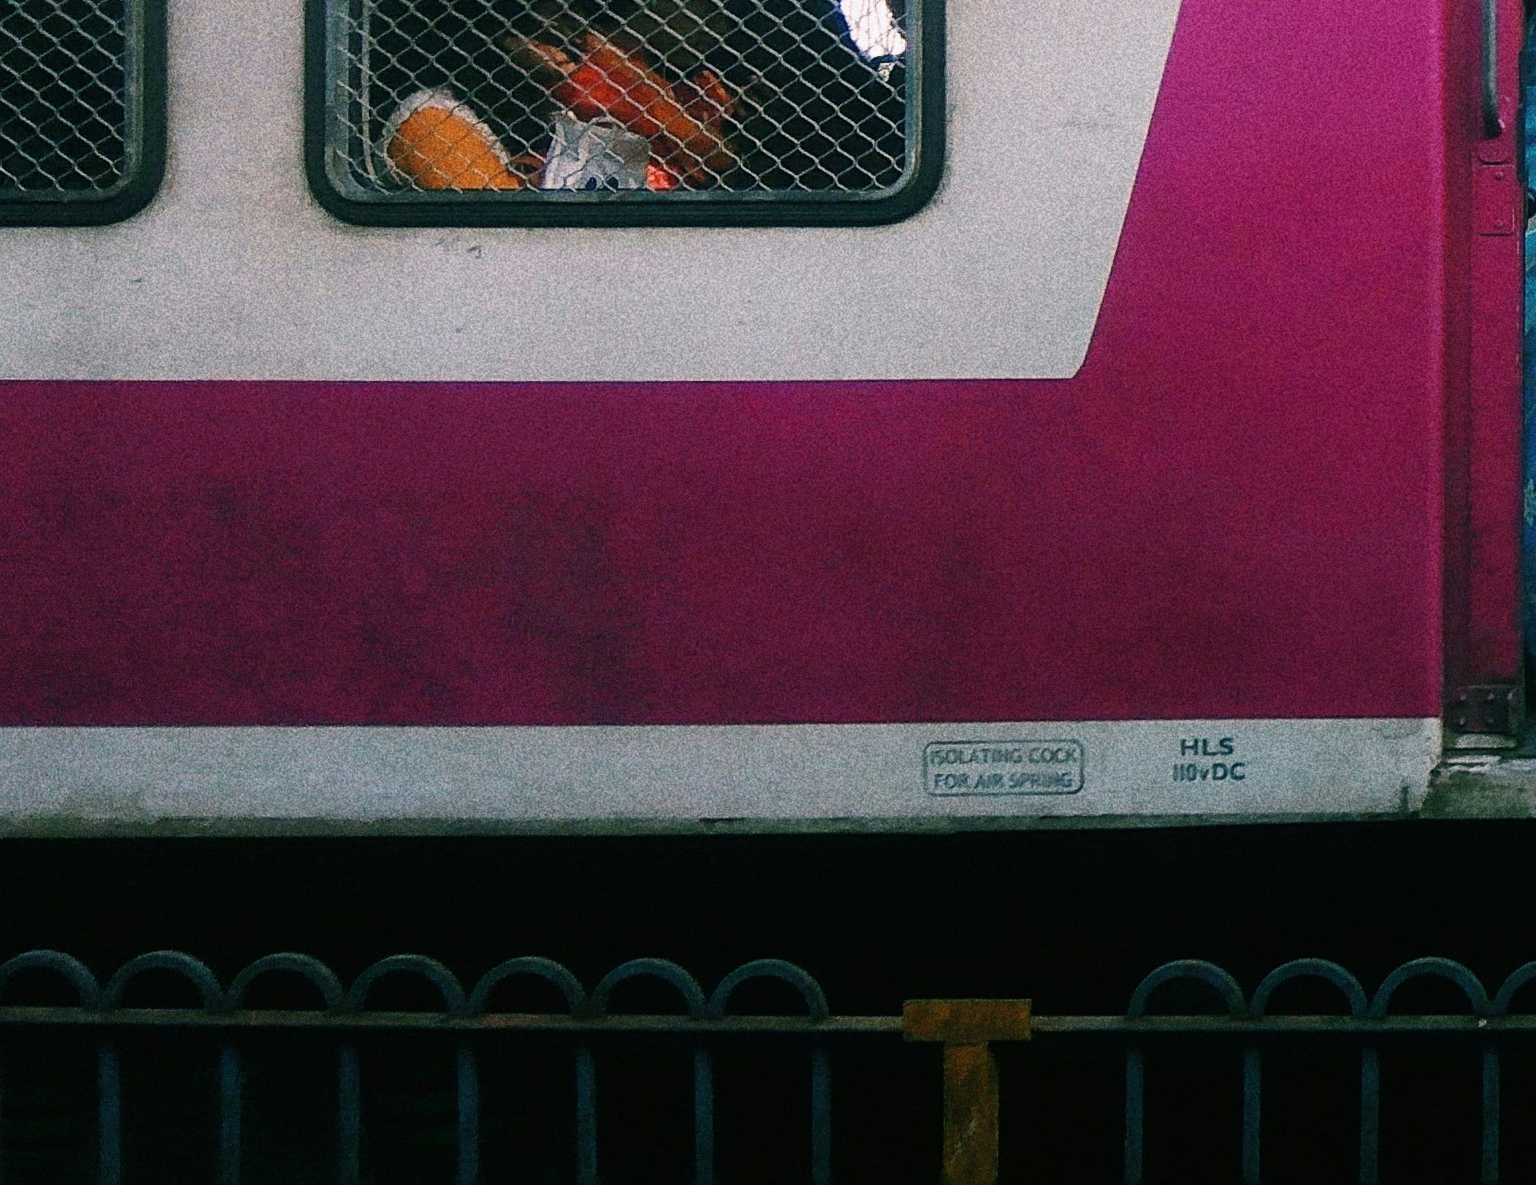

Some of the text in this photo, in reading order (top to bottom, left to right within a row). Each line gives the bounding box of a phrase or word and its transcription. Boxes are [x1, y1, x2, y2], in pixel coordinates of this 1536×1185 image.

[1028, 745, 1077, 764] COCK
[1180, 737, 1234, 756] HLS
[933, 771, 1073, 790] FOR AIR SPRING
